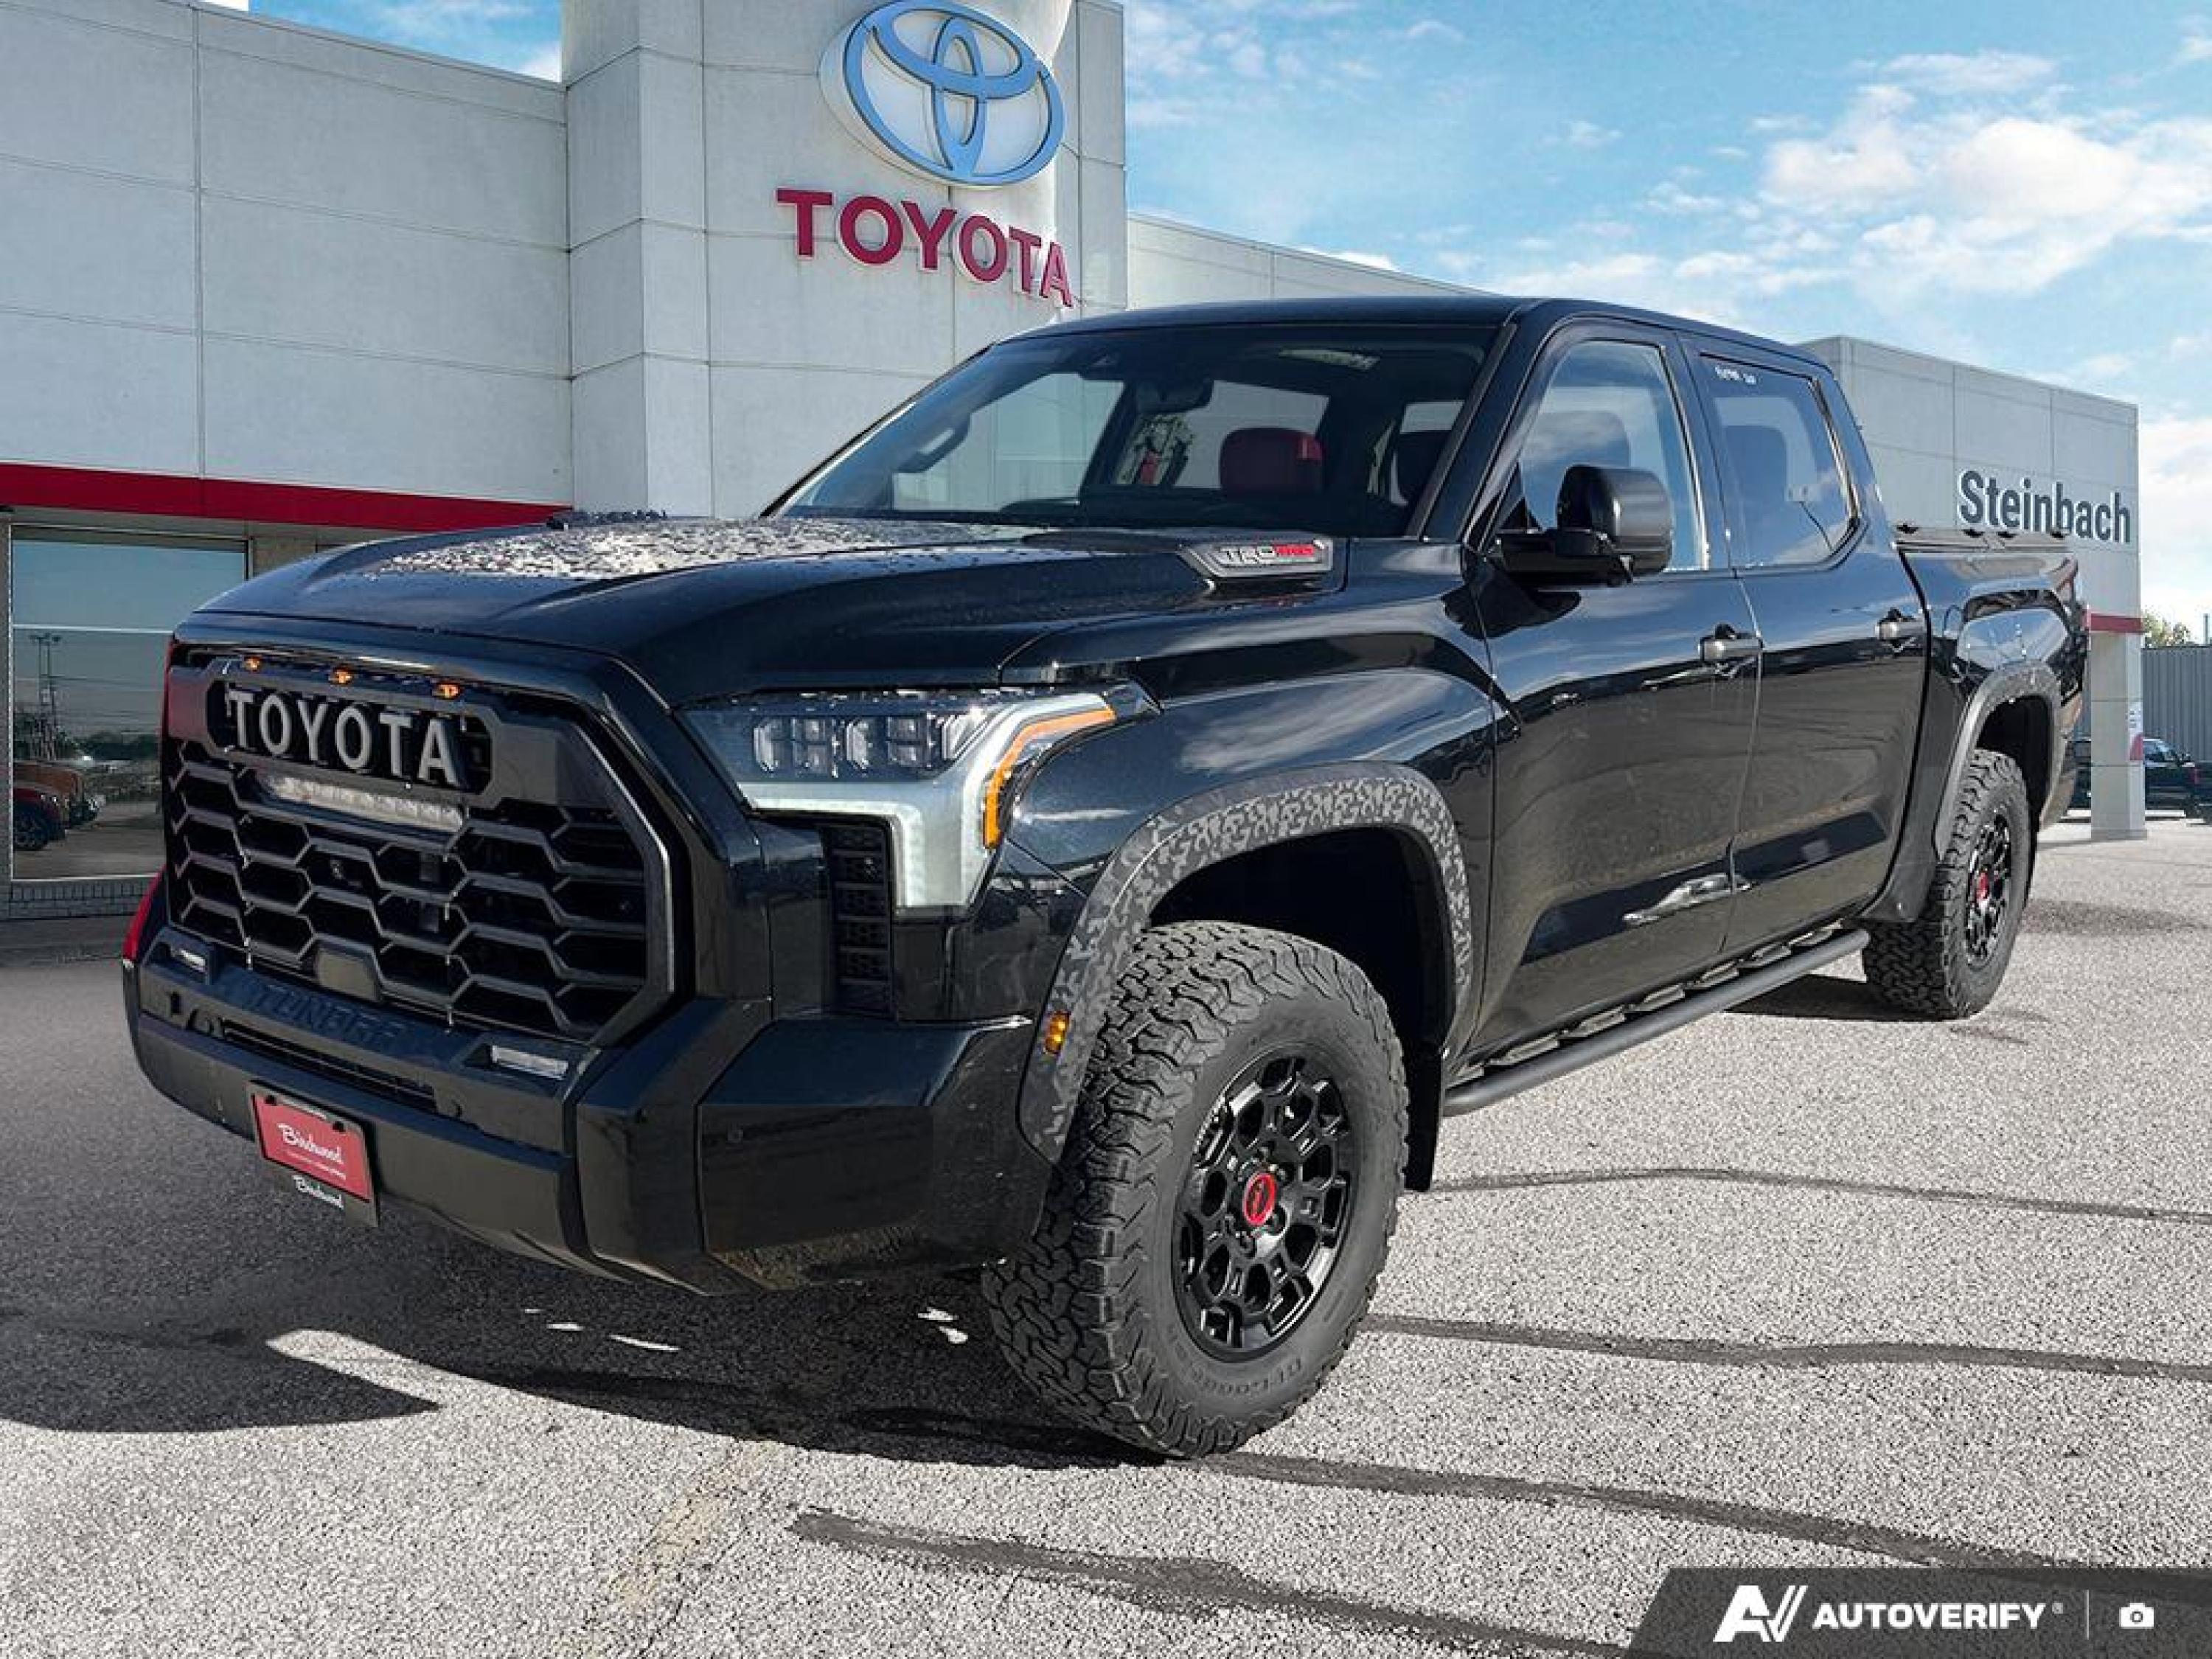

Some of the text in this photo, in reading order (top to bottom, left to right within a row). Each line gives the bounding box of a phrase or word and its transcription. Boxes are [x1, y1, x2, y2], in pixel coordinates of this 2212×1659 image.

[776, 188, 1074, 307] TOYOTA
[1958, 470, 2130, 542] Steinbach
[228, 688, 459, 786] TOYOTA
